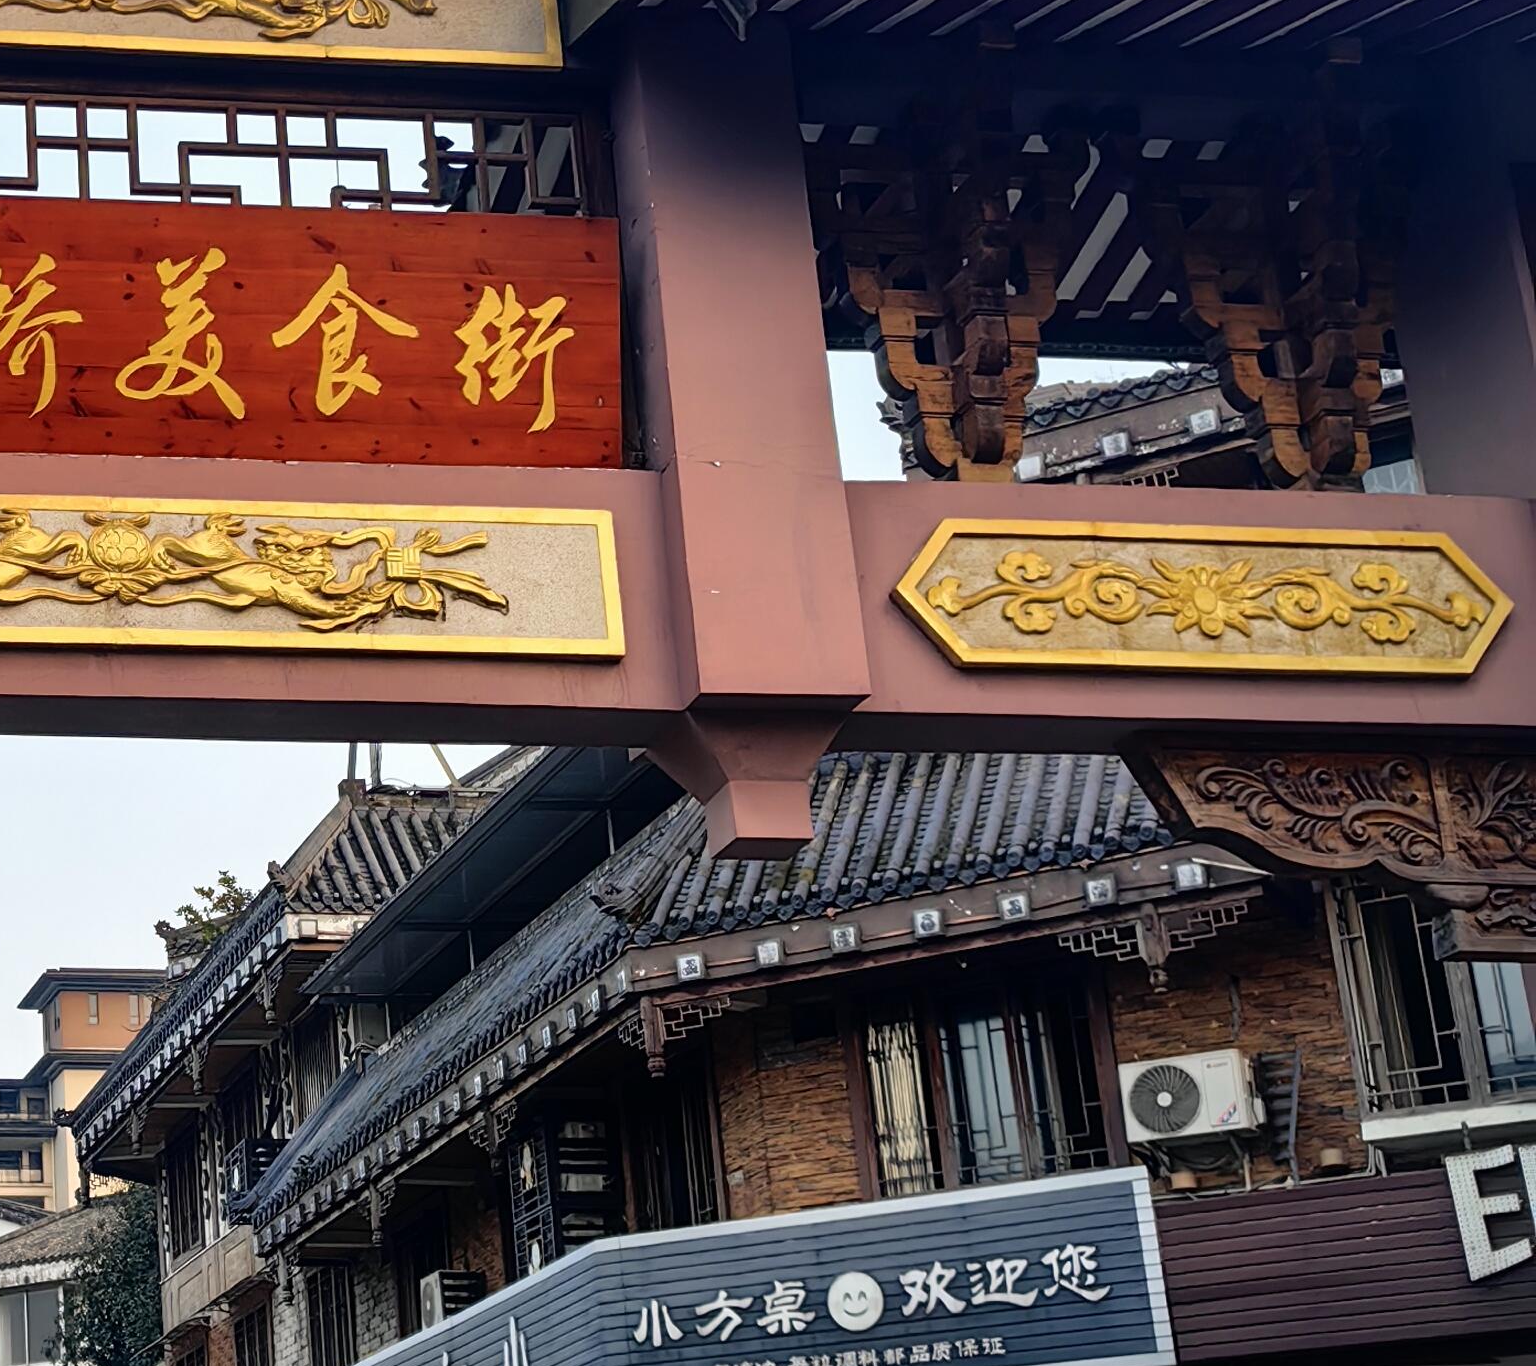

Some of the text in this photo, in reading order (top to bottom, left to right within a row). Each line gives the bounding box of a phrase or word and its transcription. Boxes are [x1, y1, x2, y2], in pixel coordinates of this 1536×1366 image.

[1445, 1143, 1536, 1282] E
[632, 1241, 1112, 1349] 小方桌 欢迎您
